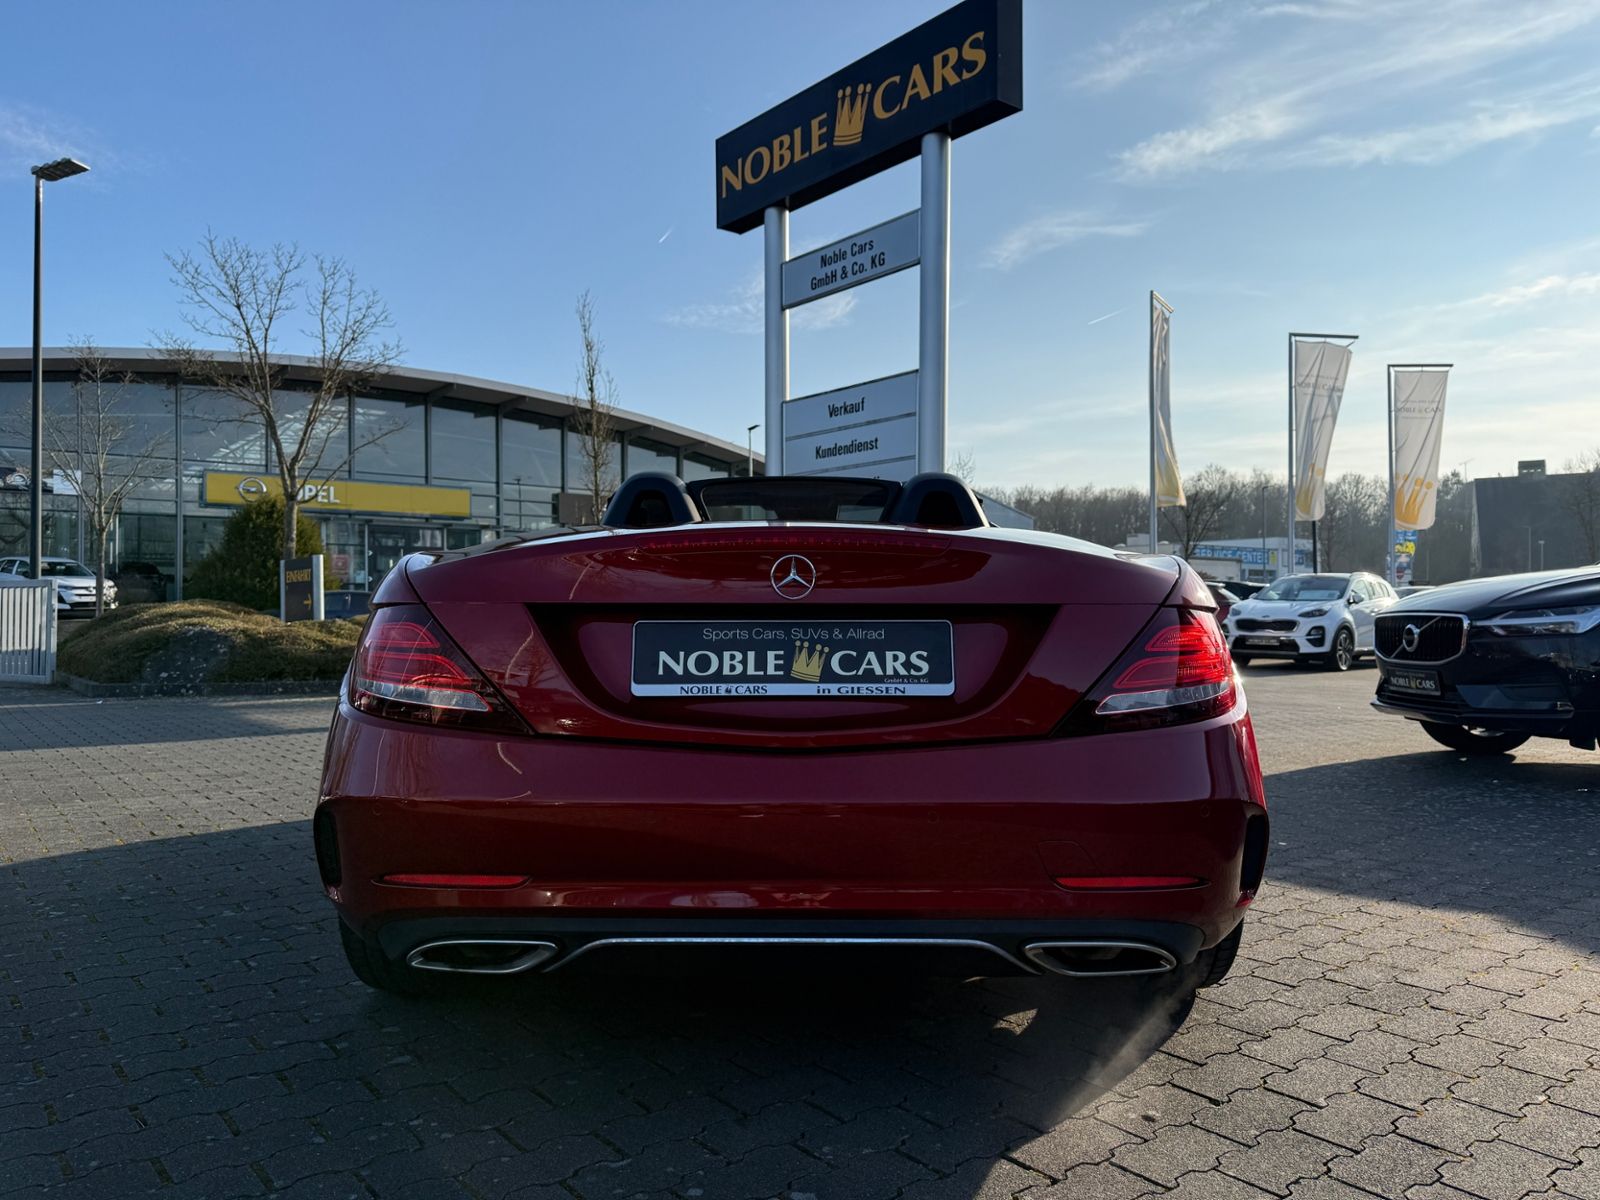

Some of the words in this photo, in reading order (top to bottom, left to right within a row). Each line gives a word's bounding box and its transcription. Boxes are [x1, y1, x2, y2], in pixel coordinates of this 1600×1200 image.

[721, 113, 828, 199] NOBLE
[872, 31, 987, 120] CARS
[820, 250, 848, 269] Noble
[850, 239, 875, 257] Cars
[810, 269, 838, 291] GmbH
[840, 265, 849, 280] &
[851, 261, 868, 277] Co.
[870, 252, 886, 270] KG
[828, 397, 866, 418] Verkauf
[815, 437, 879, 460] Kundendienst
[702, 628, 749, 642] Sports
[752, 628, 788, 641] Cars,
[791, 628, 829, 640] SUVs
[832, 628, 843, 640] &
[847, 628, 885, 640] Allrad
[657, 650, 785, 676] NOBLE
[830, 650, 930, 676] CARS
[680, 685, 722, 695] NOBLE
[735, 685, 768, 695] CARS
[817, 685, 831, 695] in
[837, 686, 906, 695] GIESSEN
[1416, 679, 1435, 689] CARS
